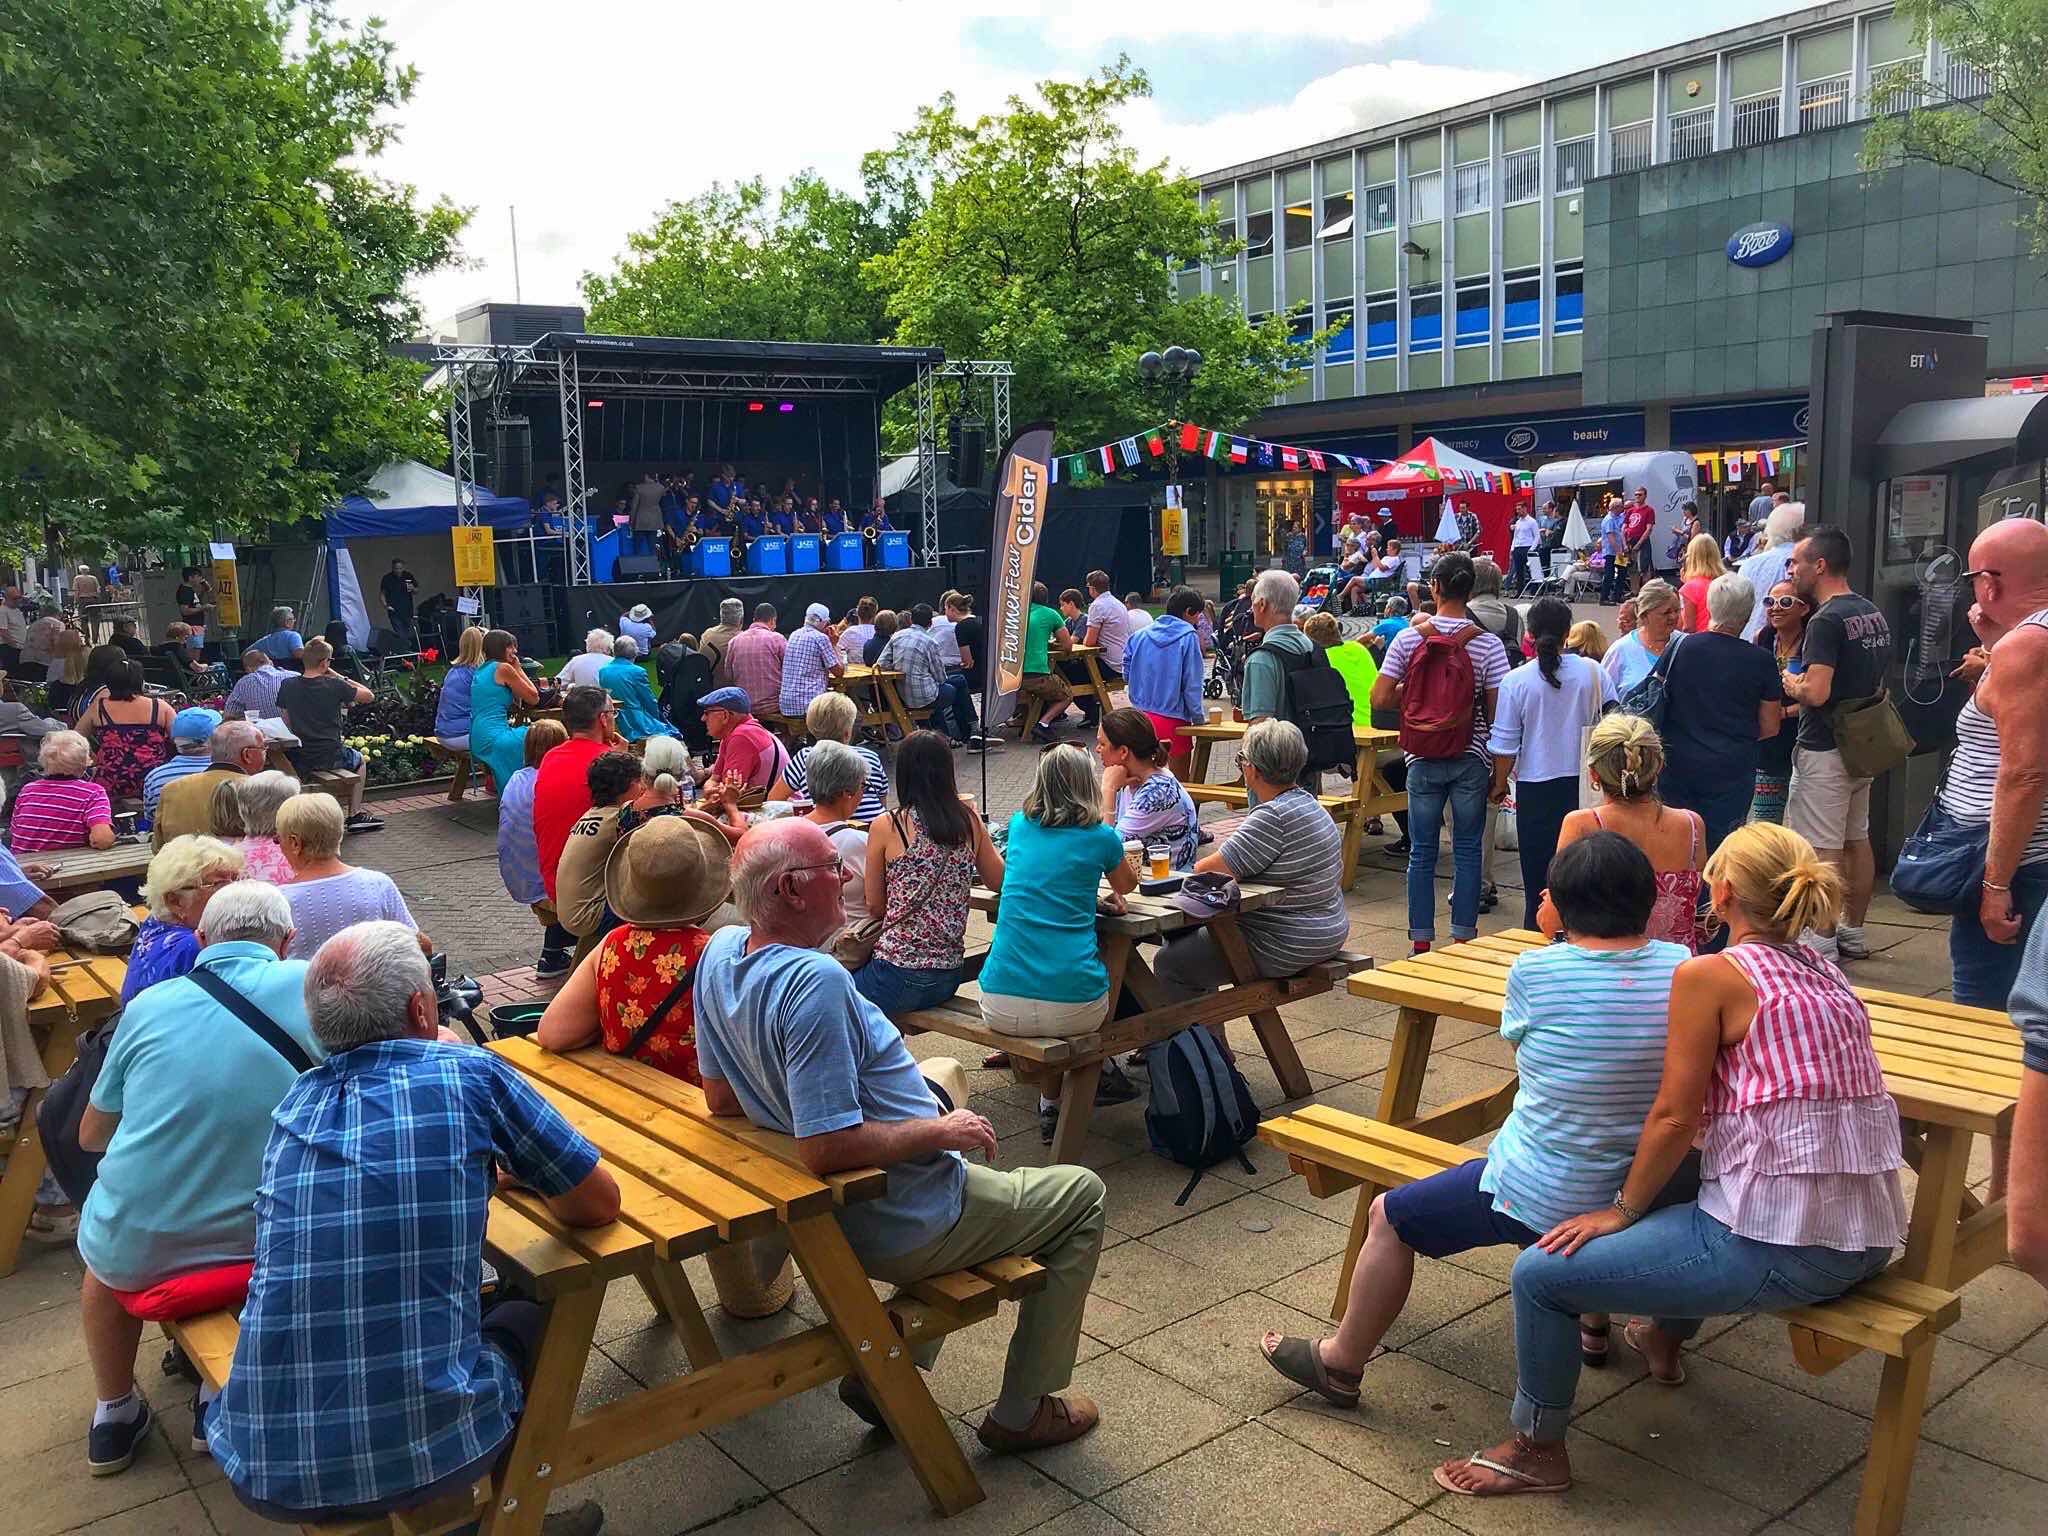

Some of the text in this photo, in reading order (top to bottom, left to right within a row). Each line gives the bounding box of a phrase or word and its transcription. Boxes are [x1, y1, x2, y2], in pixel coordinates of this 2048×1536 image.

[1734, 229, 1780, 260] Boots
[1910, 354, 1925, 368] BT
[1573, 428, 1609, 441] beauty
[1016, 467, 1037, 545] Cider
[218, 581, 232, 594] AZZ
